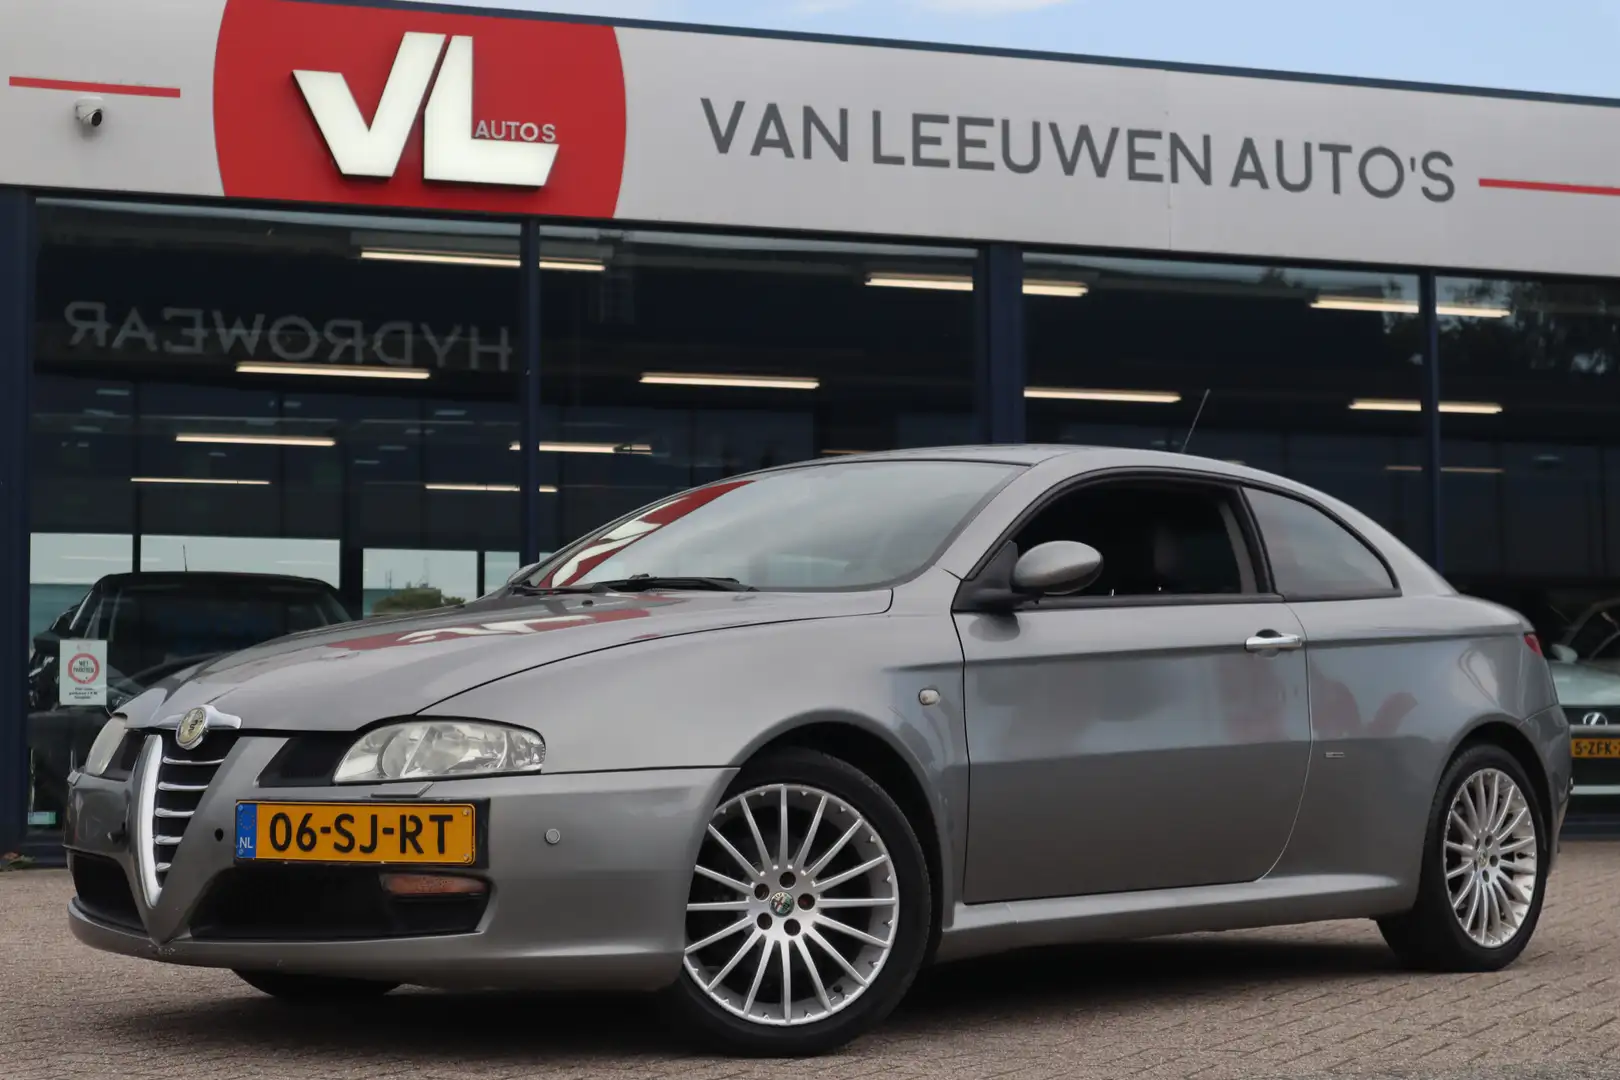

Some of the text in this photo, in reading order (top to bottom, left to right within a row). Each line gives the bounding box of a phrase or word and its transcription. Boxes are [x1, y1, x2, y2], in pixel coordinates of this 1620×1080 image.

[292, 31, 560, 187] VL
[475, 120, 557, 143] AUTOS
[701, 97, 1456, 203] VAN LEEUWEN AUTO'S
[239, 837, 254, 849] NL
[269, 812, 454, 855] 06-SJ-RT
